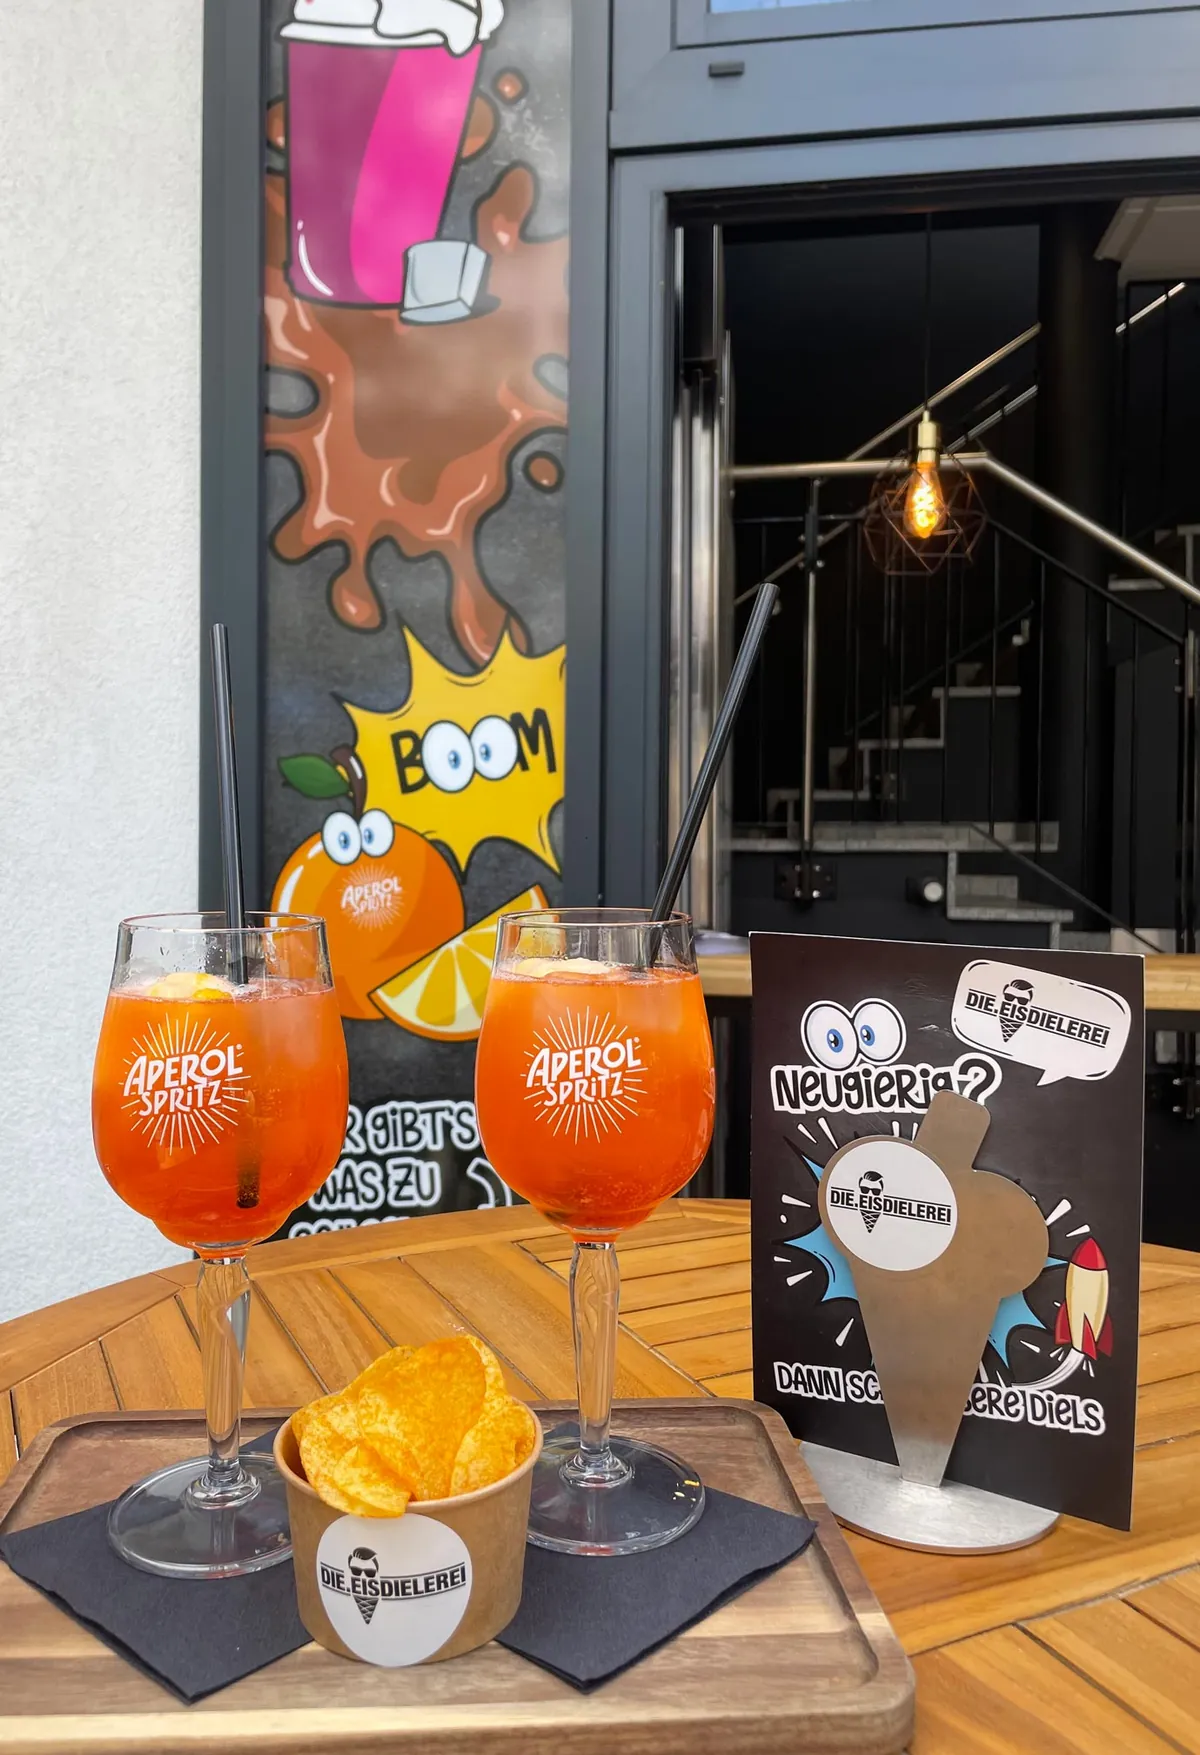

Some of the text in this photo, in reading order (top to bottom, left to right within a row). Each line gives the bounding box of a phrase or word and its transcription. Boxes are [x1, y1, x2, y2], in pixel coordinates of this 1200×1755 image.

[391, 708, 557, 794] BOOM
[341, 876, 403, 909] APEROL
[965, 990, 1111, 1047] DIE.EISDIELEREI
[124, 1044, 243, 1097] APEROL
[526, 1038, 641, 1088] APEROL
[391, 1161, 437, 1202] ZU
[829, 1186, 952, 1224] DIE.EISDIELEREI
[775, 1363, 843, 1400] DANN
[320, 1564, 467, 1598] DIE.EISDIELEREI
